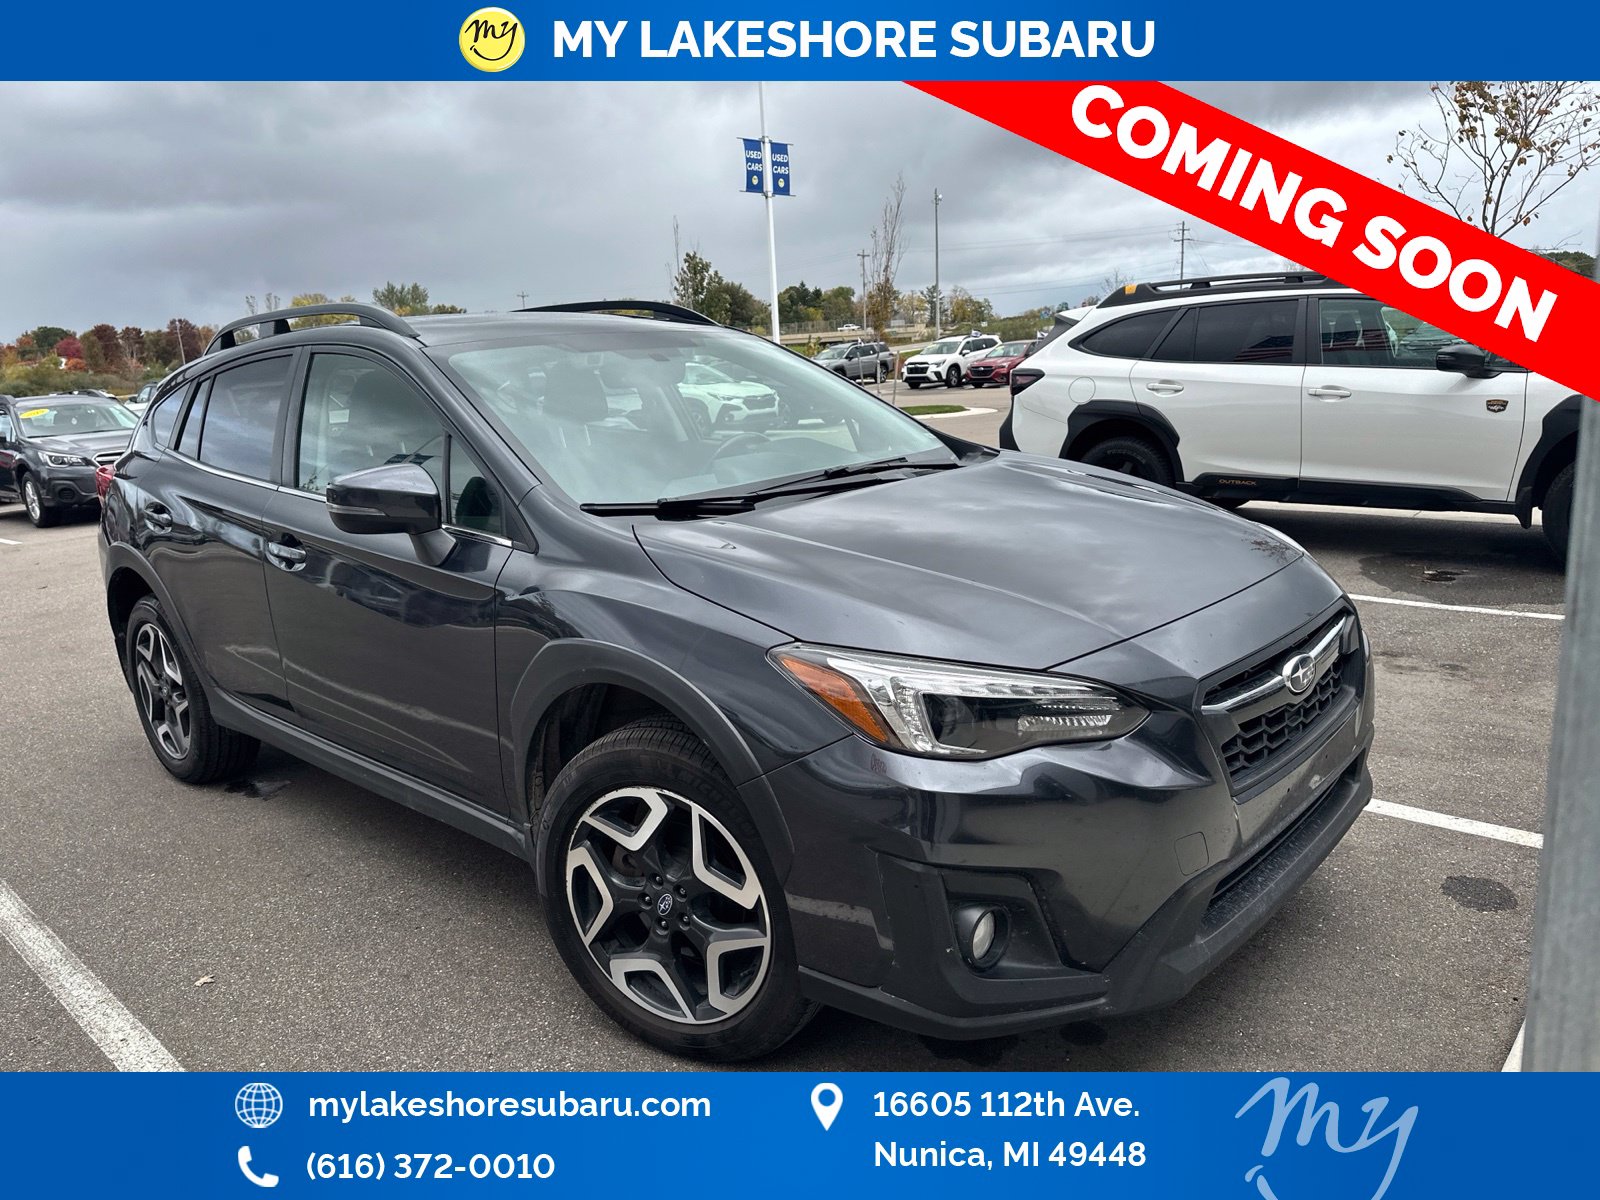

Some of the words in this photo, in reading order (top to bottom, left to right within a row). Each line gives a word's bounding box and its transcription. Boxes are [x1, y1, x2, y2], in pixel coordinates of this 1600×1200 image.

[745, 150, 762, 160] USED
[771, 153, 789, 163] USED
[746, 162, 763, 172] CARS
[772, 165, 789, 175] CARS
[1218, 478, 1257, 486] OUTBACK
